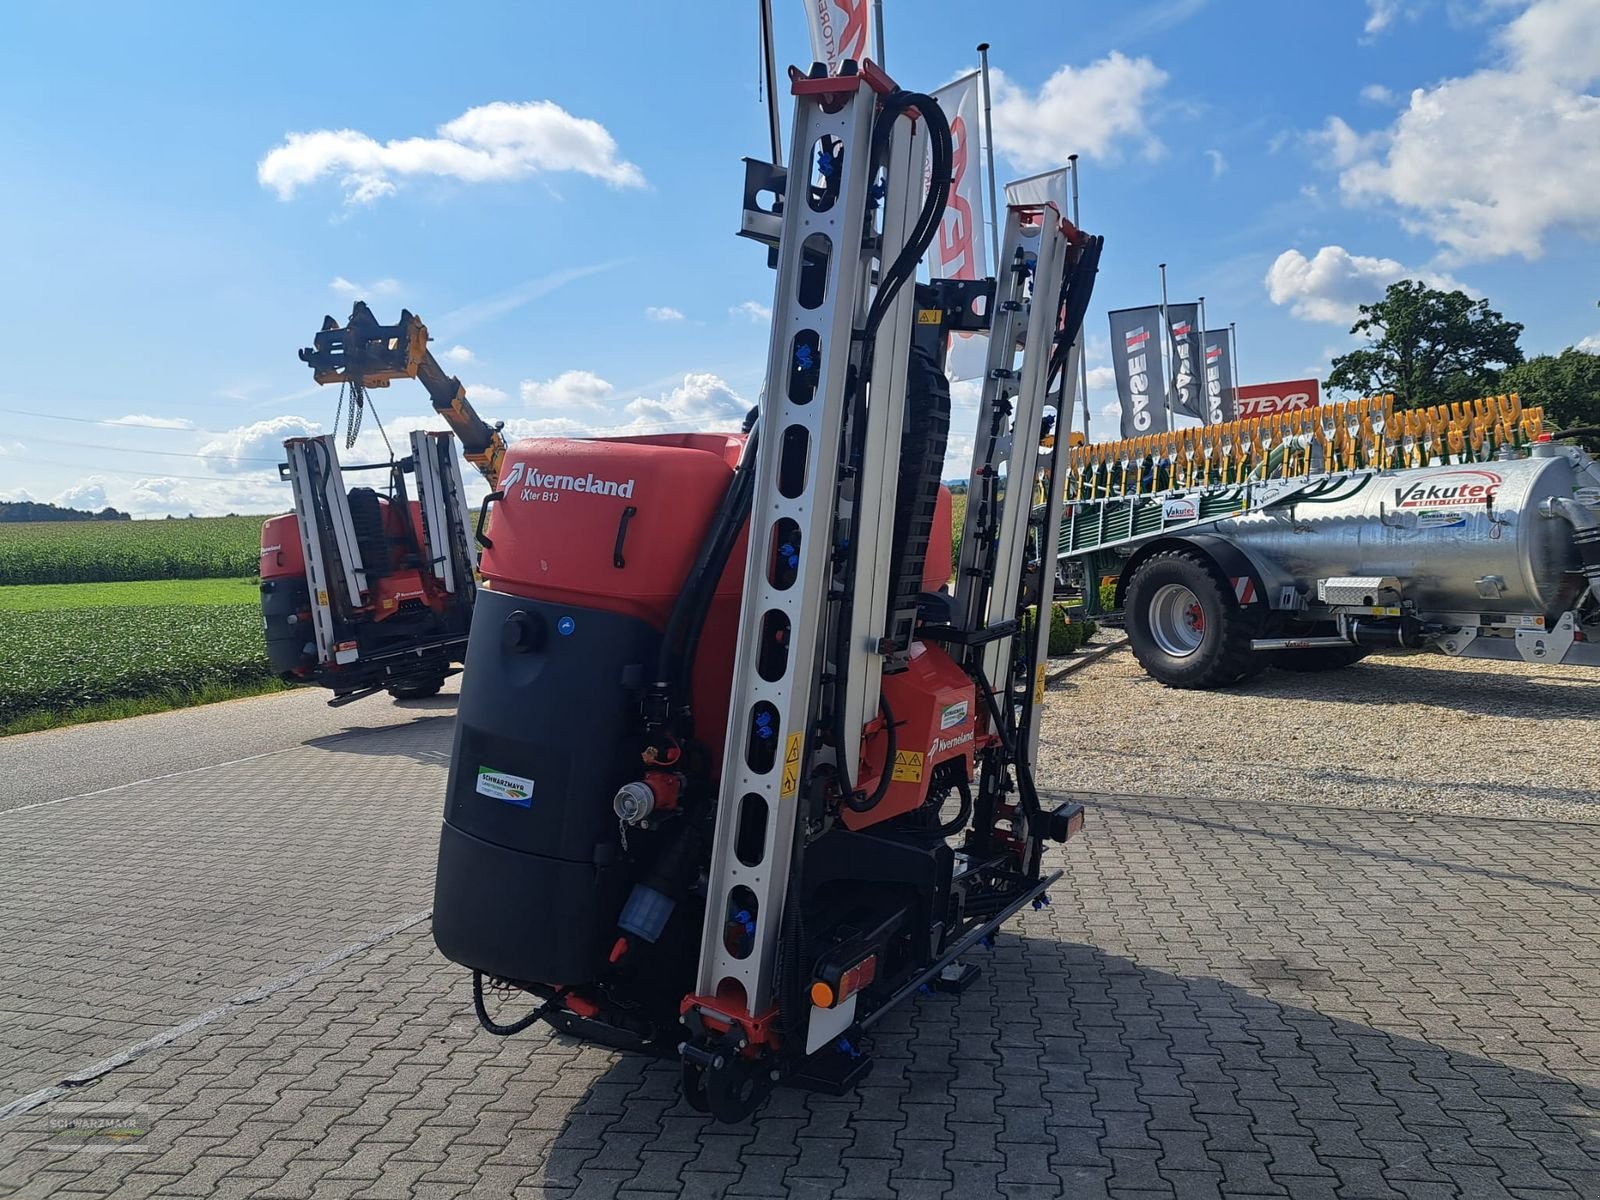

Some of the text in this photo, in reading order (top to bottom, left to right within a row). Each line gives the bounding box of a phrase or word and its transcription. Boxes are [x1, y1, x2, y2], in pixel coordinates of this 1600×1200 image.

[1233, 393, 1310, 415] STEYR
[525, 468, 635, 498] Kverneland
[542, 491, 559, 502] B13
[1395, 482, 1501, 507] Vakutec
[1166, 506, 1194, 518] Vakutec
[939, 728, 974, 752] Kverneland
[482, 773, 525, 790] SCHWARZMAYR
